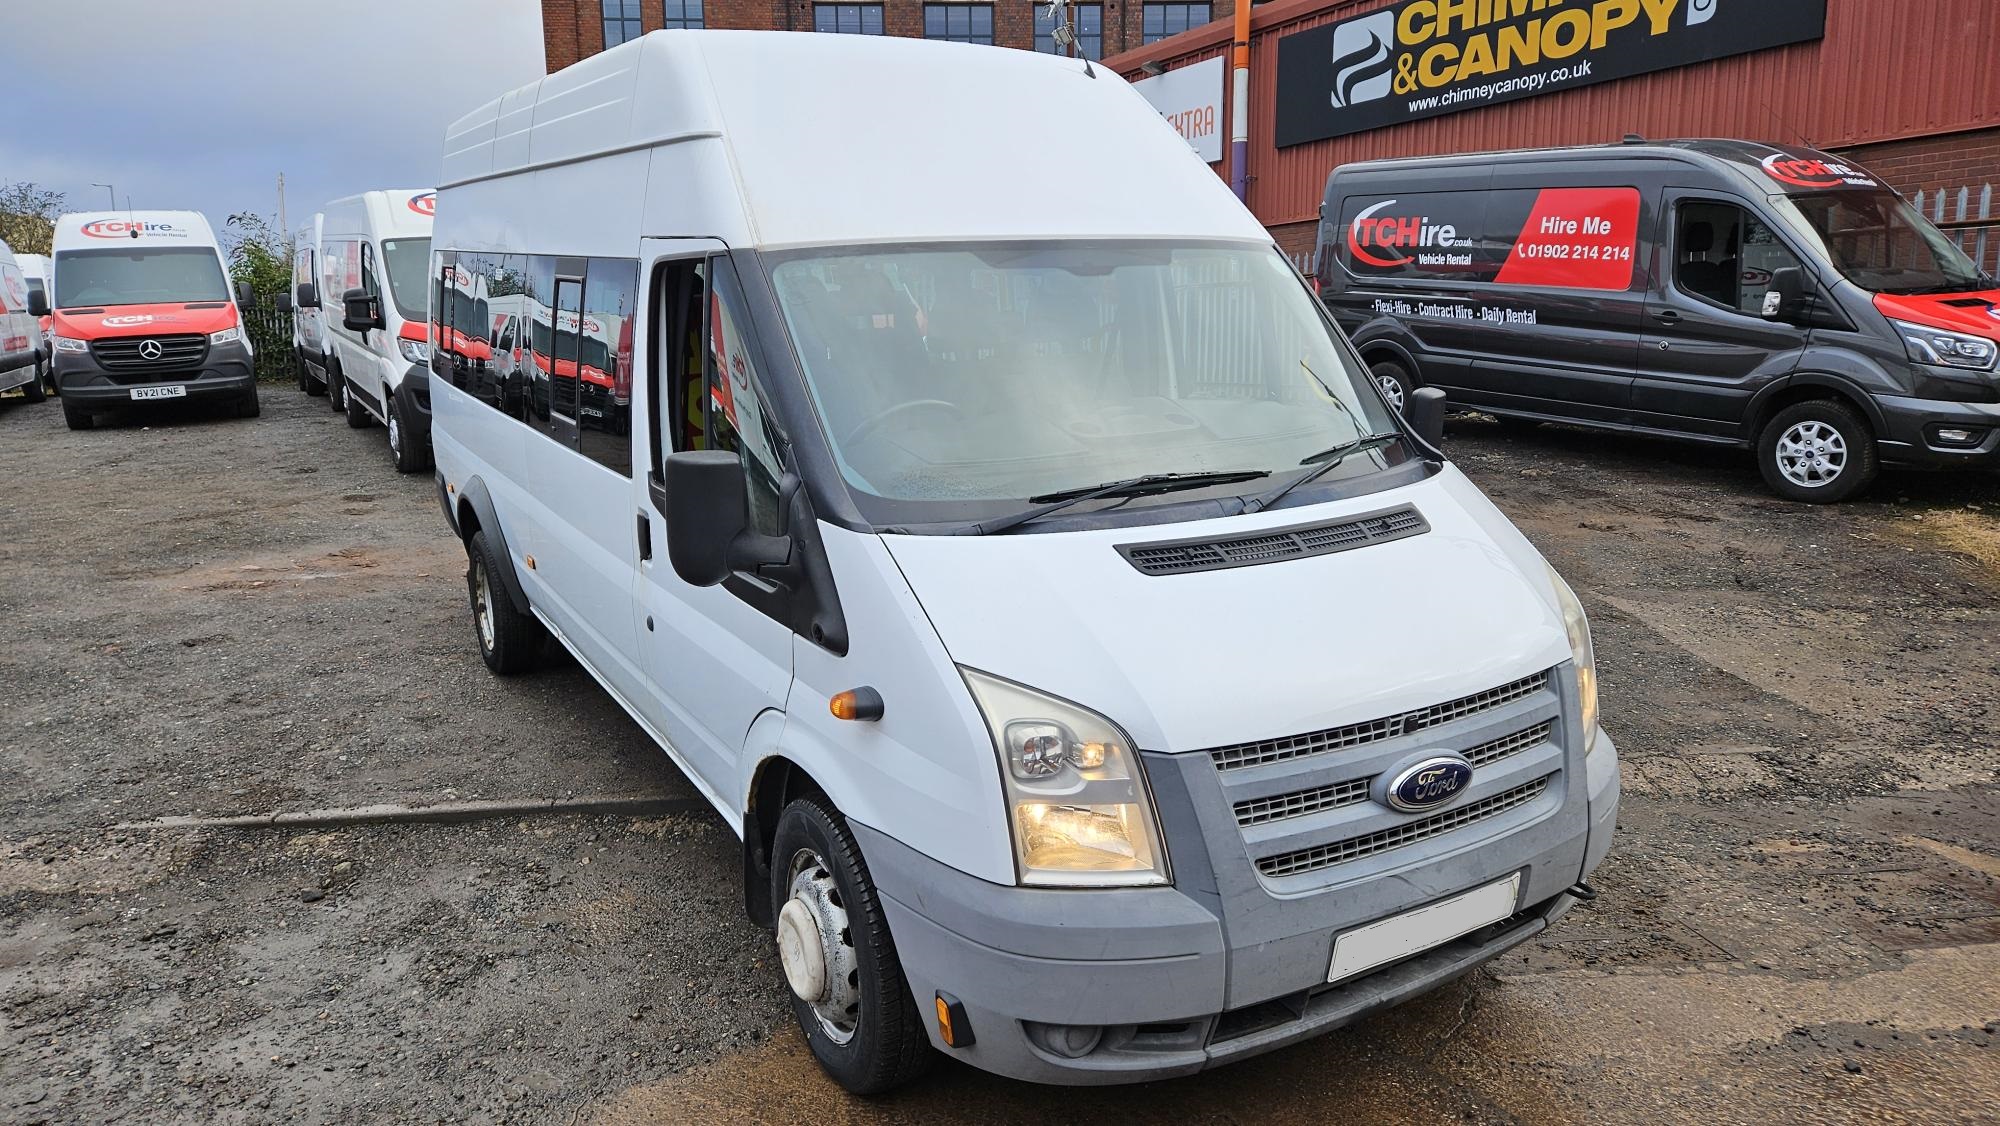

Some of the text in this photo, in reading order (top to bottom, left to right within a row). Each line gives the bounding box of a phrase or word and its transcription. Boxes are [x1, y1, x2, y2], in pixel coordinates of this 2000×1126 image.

[1393, 0, 1679, 95] &CANOPY
[1409, 60, 1592, 112] www.chimneycanopy.co.uk
[1540, 216, 1611, 235] Hire Me
[1419, 253, 1472, 265] Vehicle Rental
[1528, 244, 1630, 260] 01902 214 214
[1375, 299, 1537, 325] Flexi-Hire Contract Hire Daily Rental
[136, 387, 180, 398] BV21 CNE
[1415, 767, 1459, 800] Ford
